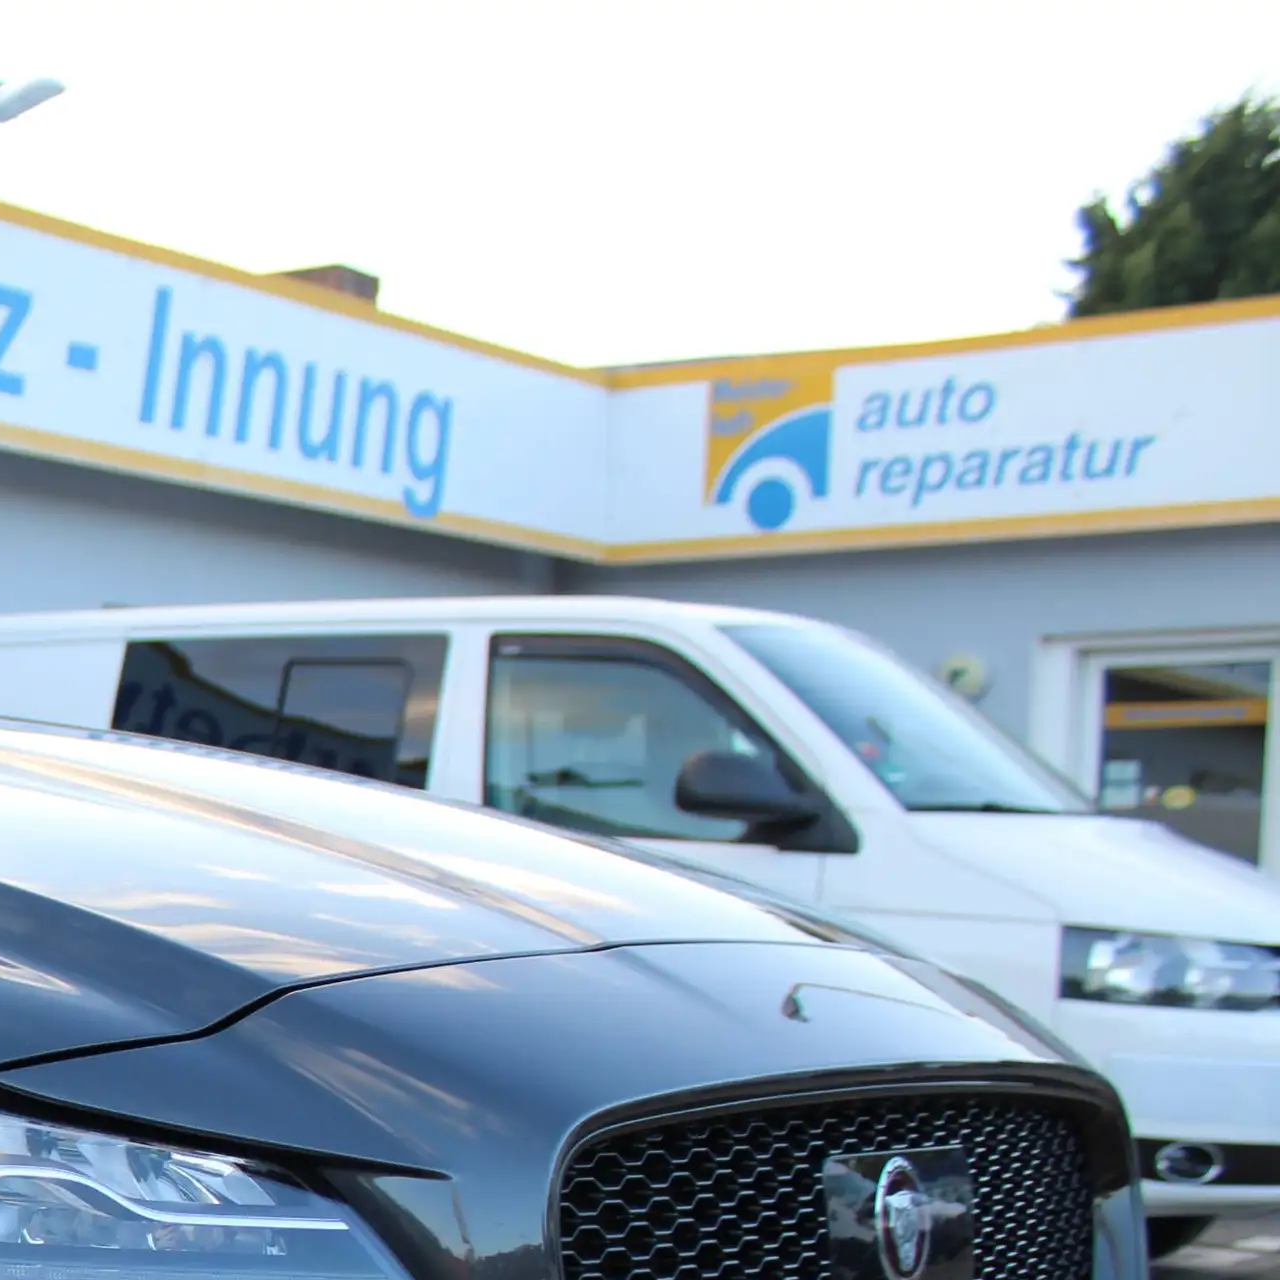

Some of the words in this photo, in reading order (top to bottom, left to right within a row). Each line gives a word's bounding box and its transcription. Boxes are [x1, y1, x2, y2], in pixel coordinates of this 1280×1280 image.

[67, 343, 98, 371] -
[139, 287, 453, 518] Innung
[855, 376, 997, 433] auto
[854, 434, 1156, 508] reparatur
